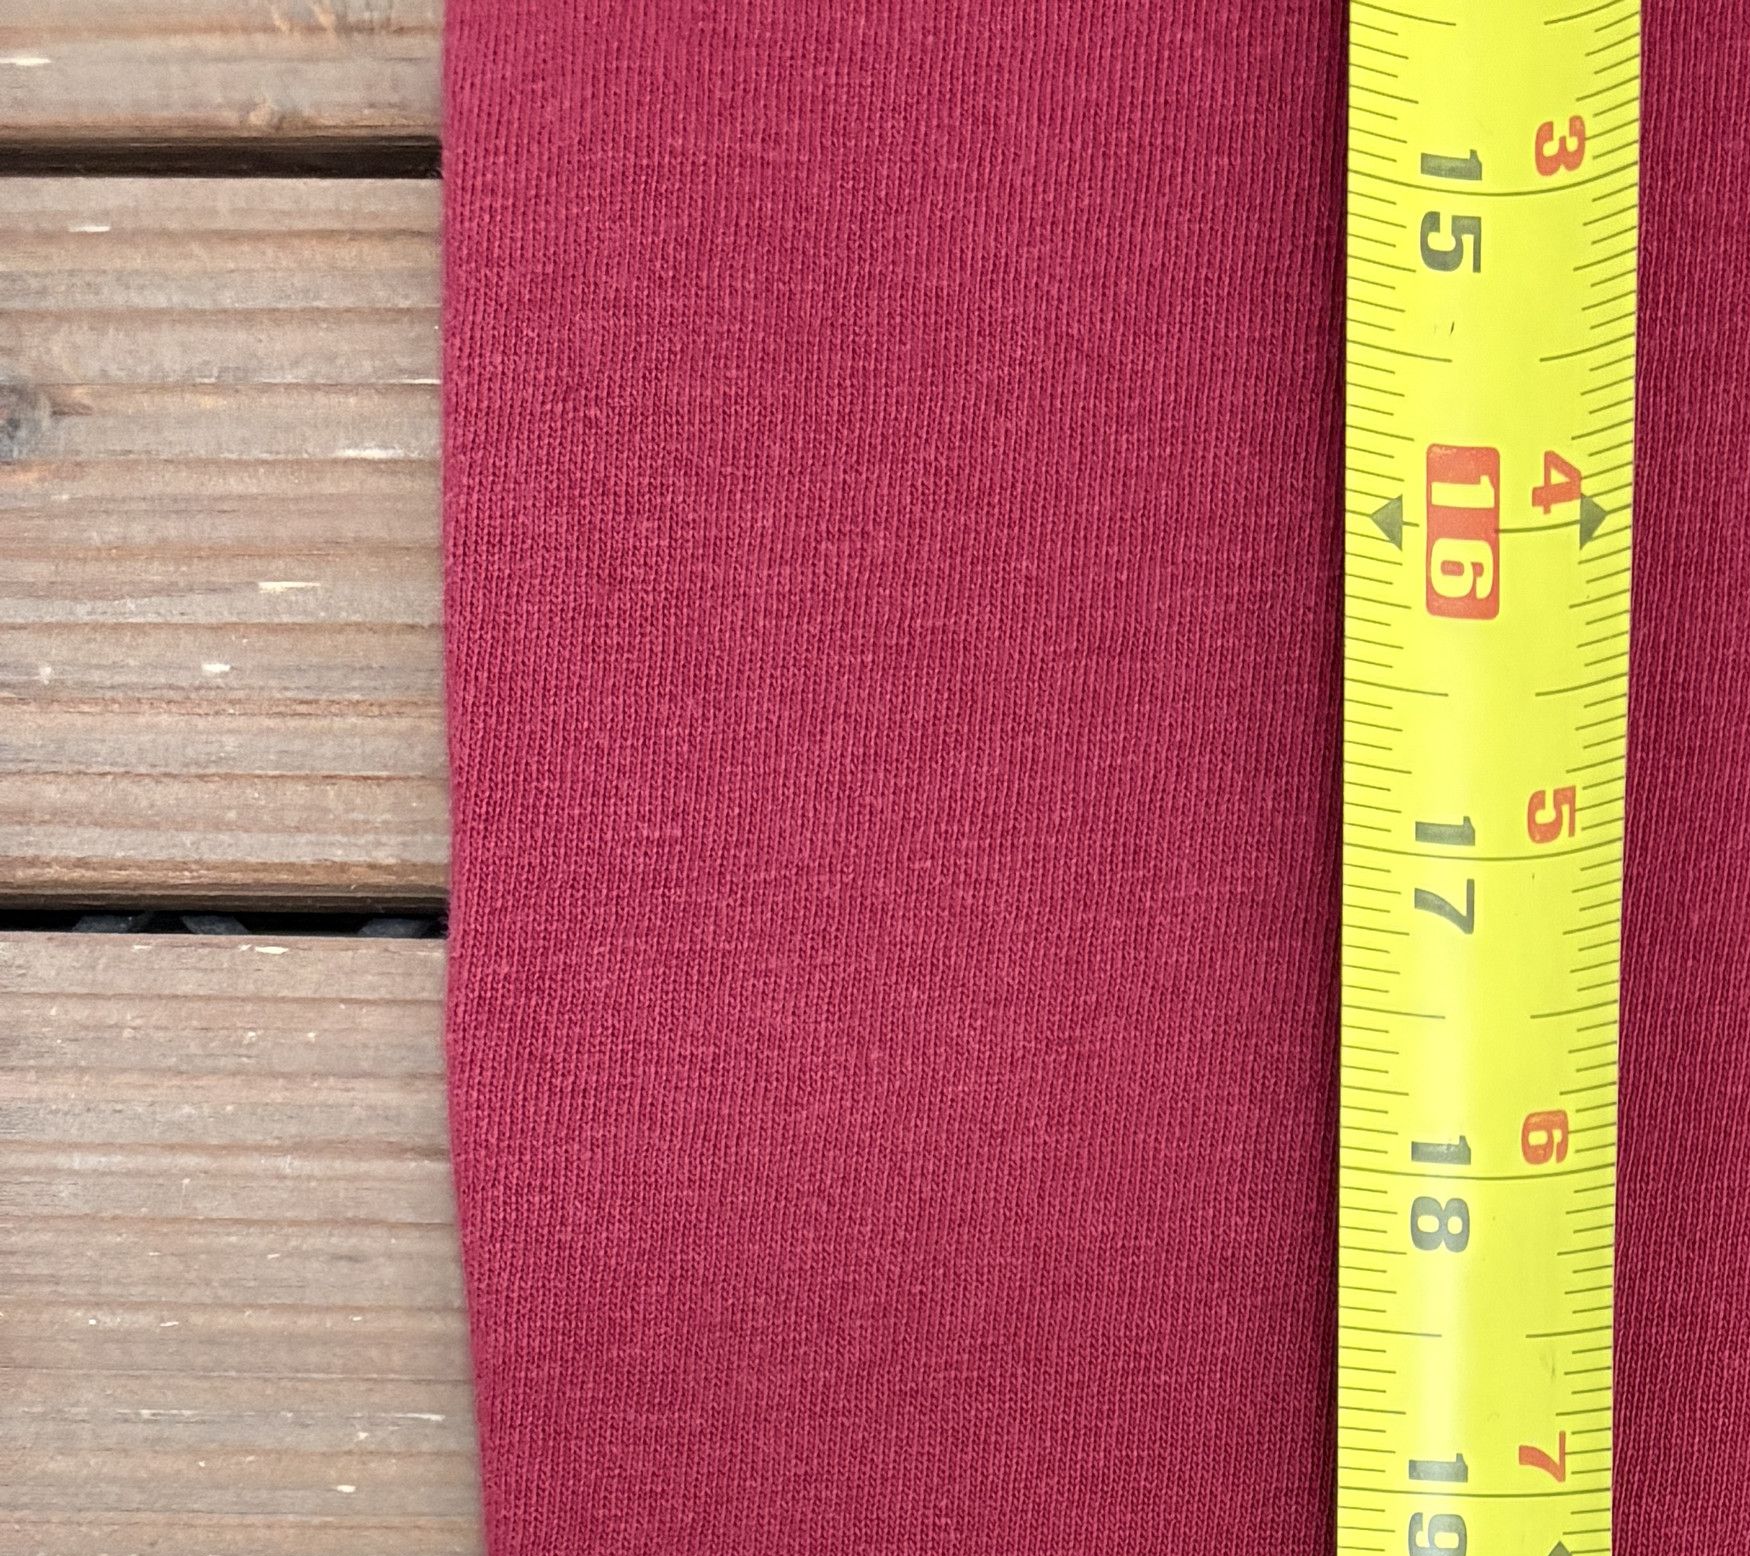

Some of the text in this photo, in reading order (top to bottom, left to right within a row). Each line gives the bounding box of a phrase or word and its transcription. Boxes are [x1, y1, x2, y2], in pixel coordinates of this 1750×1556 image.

[1535, 115, 1585, 176] 3
[1419, 149, 1483, 273] 15
[1531, 450, 1582, 514] 4
[1429, 473, 1494, 601] 16
[1527, 785, 1576, 843] 5
[1414, 816, 1475, 935] 17
[1521, 1109, 1568, 1164] 6
[1410, 1135, 1471, 1252] 18
[1518, 1431, 1566, 1482] 7
